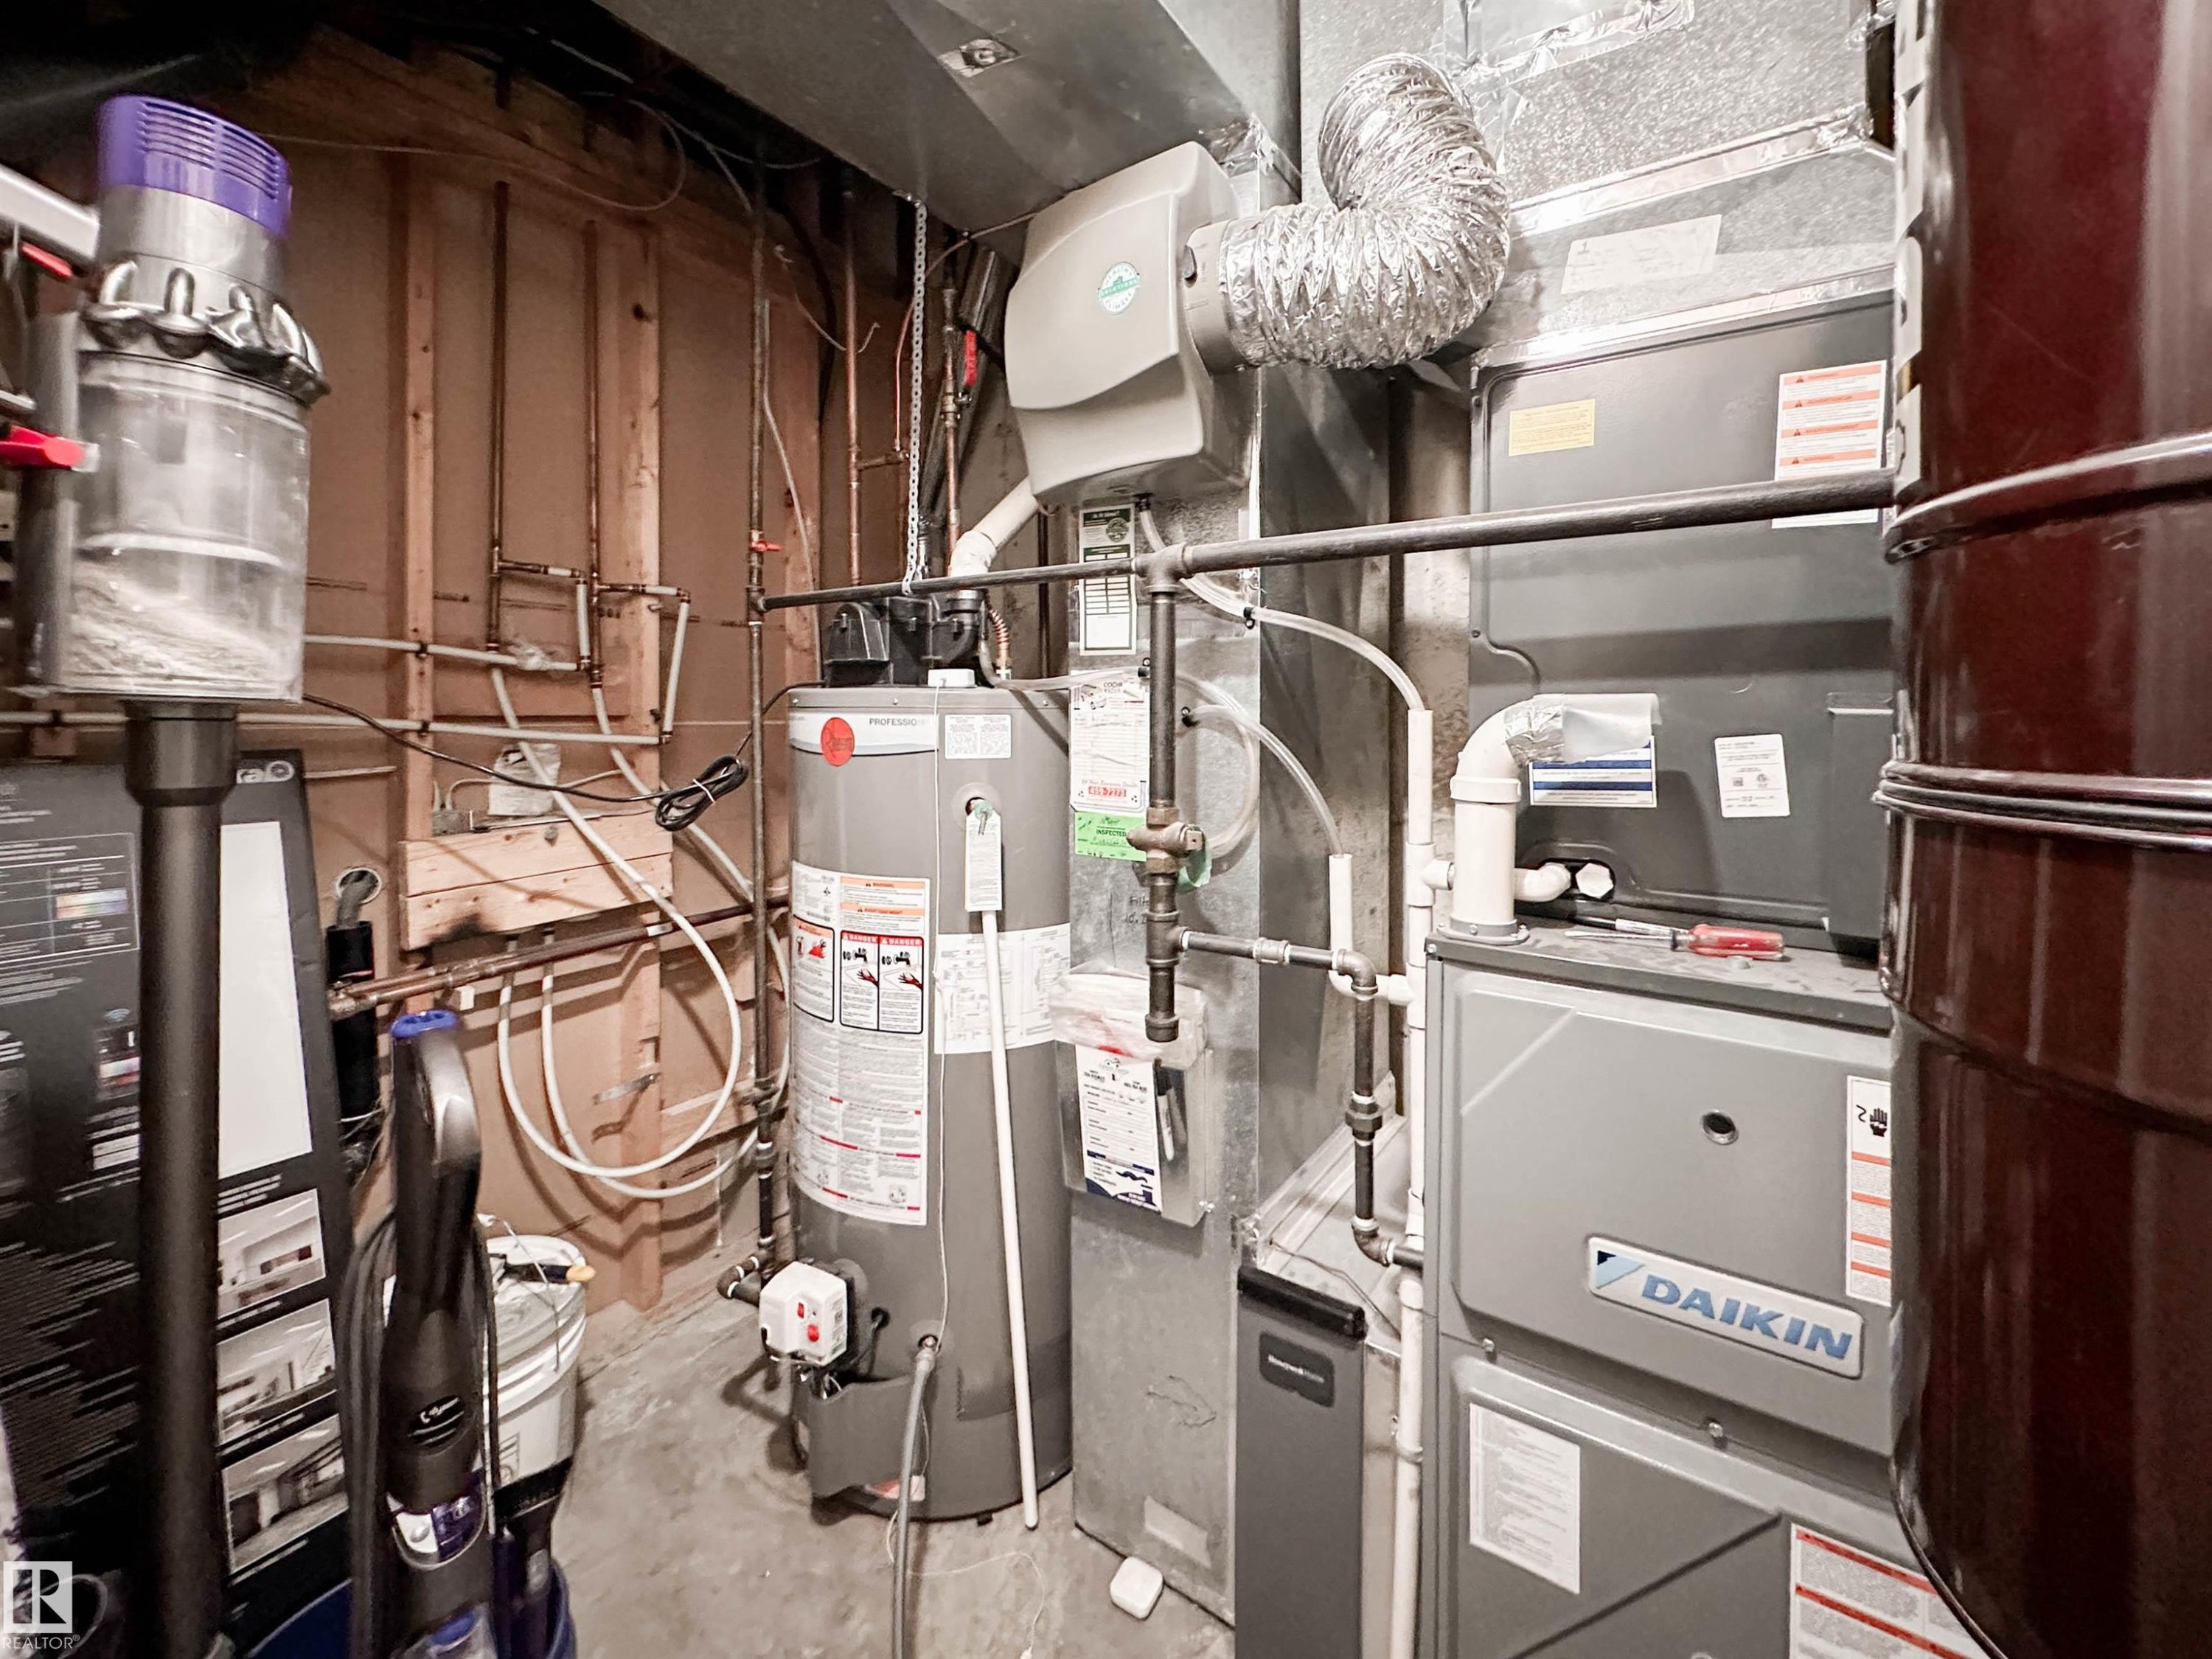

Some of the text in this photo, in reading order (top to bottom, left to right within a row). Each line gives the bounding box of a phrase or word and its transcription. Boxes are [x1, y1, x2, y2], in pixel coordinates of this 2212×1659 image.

[869, 717, 925, 726] PROFESSIO
[1096, 829, 1127, 837] INSPECTED
[1641, 1274, 1853, 1360] DAIKIN
